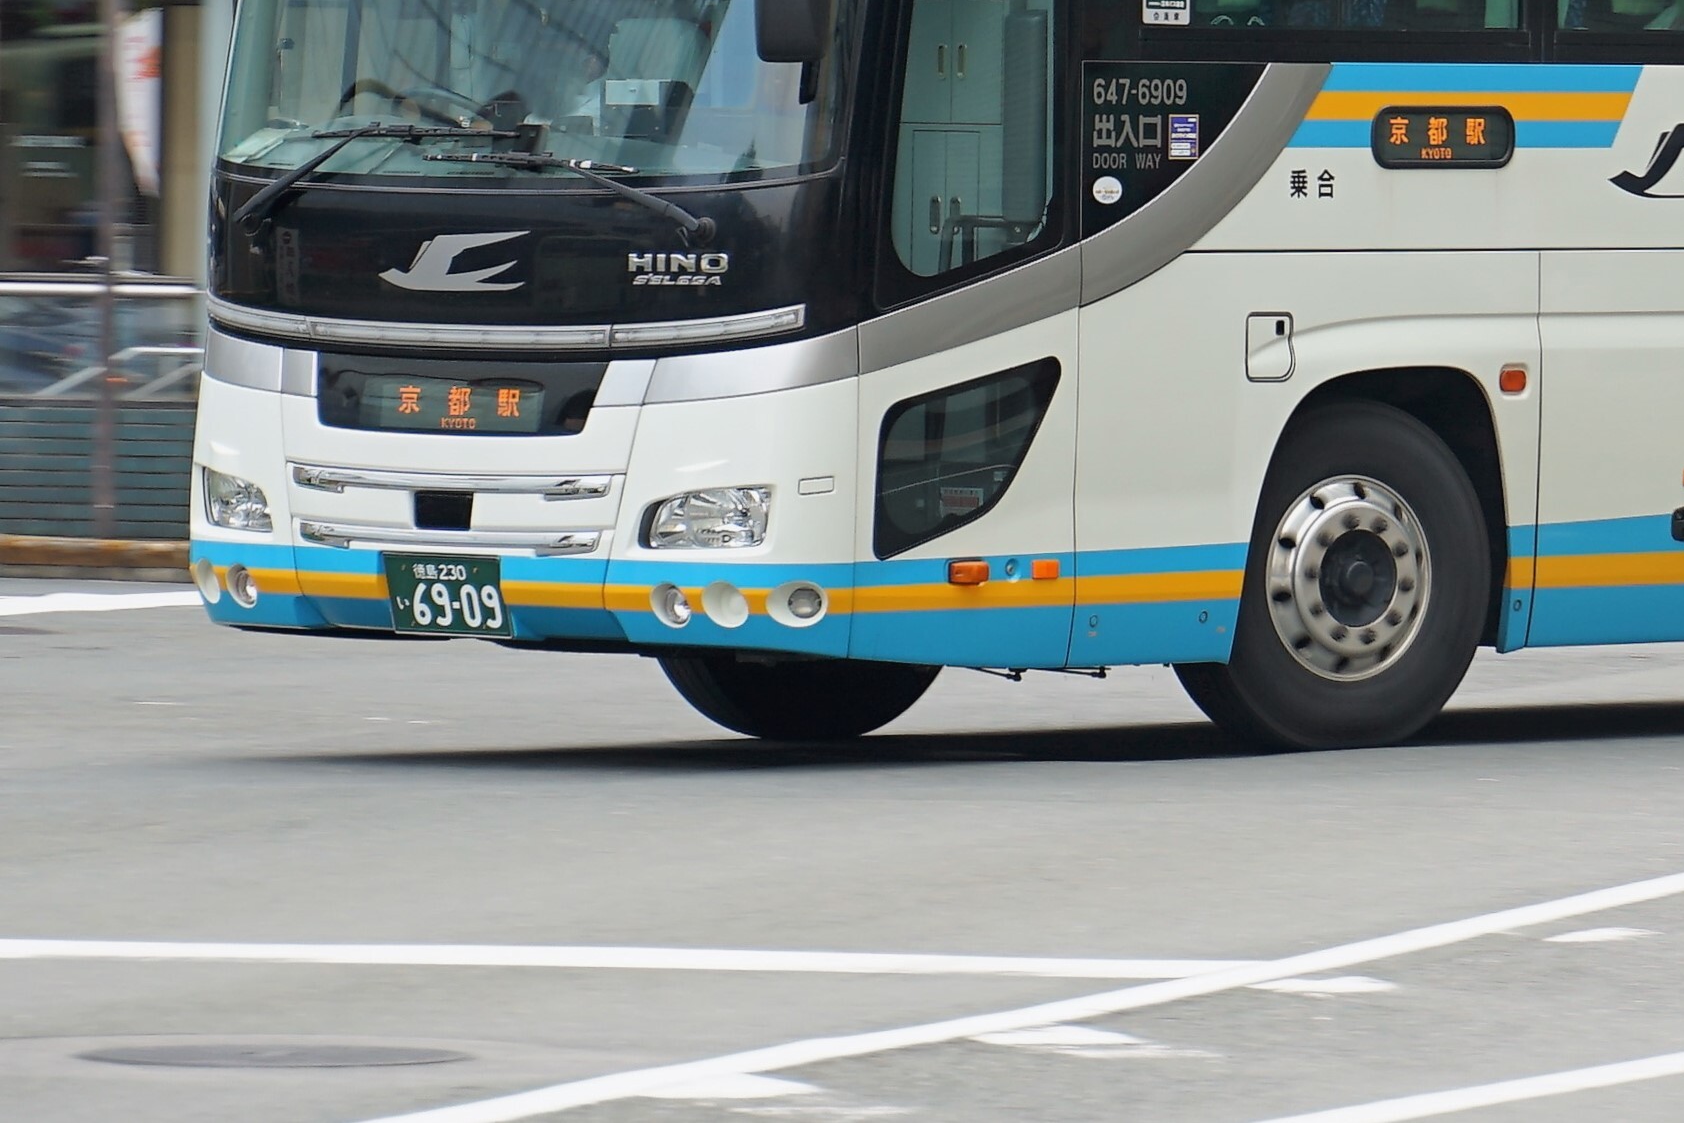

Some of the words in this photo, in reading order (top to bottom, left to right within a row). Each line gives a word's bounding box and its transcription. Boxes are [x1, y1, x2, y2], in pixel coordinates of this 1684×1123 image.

[1093, 78, 1187, 105] 647-6909
[1092, 114, 1162, 148] 出入口
[1389, 116, 1486, 146] 京都駅
[1092, 153, 1127, 169] DOOR
[1135, 153, 1162, 169] WAY
[1421, 148, 1452, 160] KYOTO
[1290, 169, 1335, 199] 乗合
[627, 253, 729, 274] HINO
[398, 385, 521, 417] 京都駅
[441, 417, 476, 429] KYOTO
[413, 582, 503, 629] 69-09
